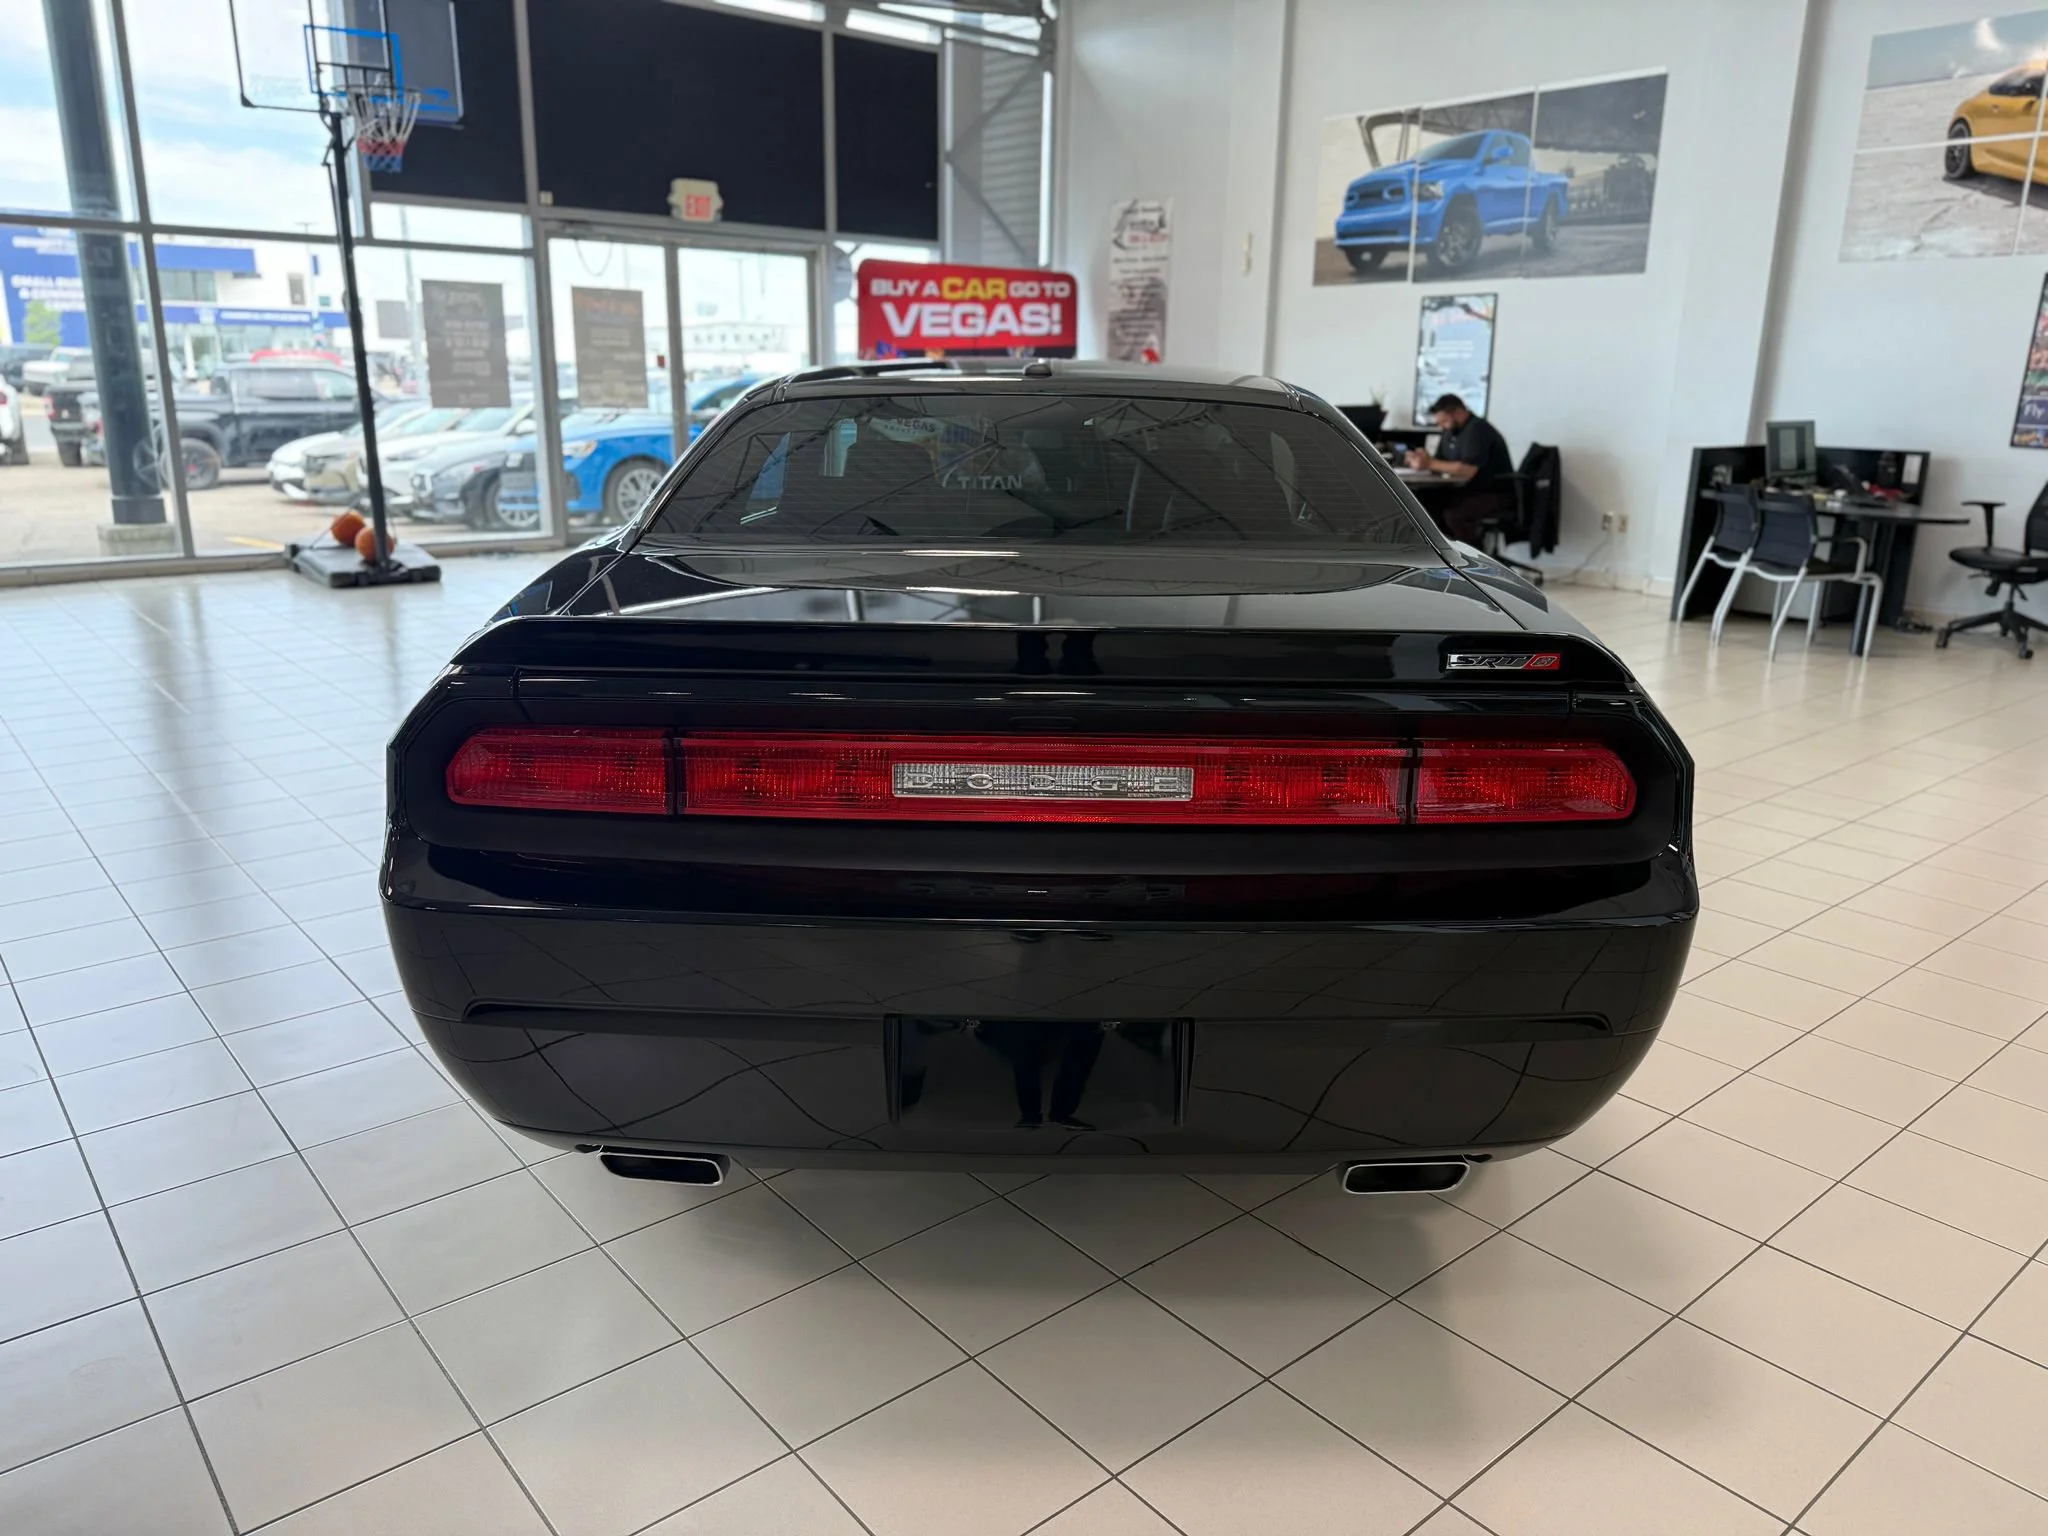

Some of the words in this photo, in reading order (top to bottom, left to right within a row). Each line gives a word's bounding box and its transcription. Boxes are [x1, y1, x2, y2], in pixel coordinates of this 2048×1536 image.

[870, 278, 920, 297] BUY
[922, 280, 940, 297] A
[941, 276, 1007, 301] CAR
[1008, 281, 1040, 298] GO
[1041, 282, 1071, 298] TO
[881, 302, 1063, 338] VEGAS!
[2024, 403, 2046, 420] Fly
[958, 475, 1023, 490] TITAN
[903, 773, 1179, 792] DODGE
